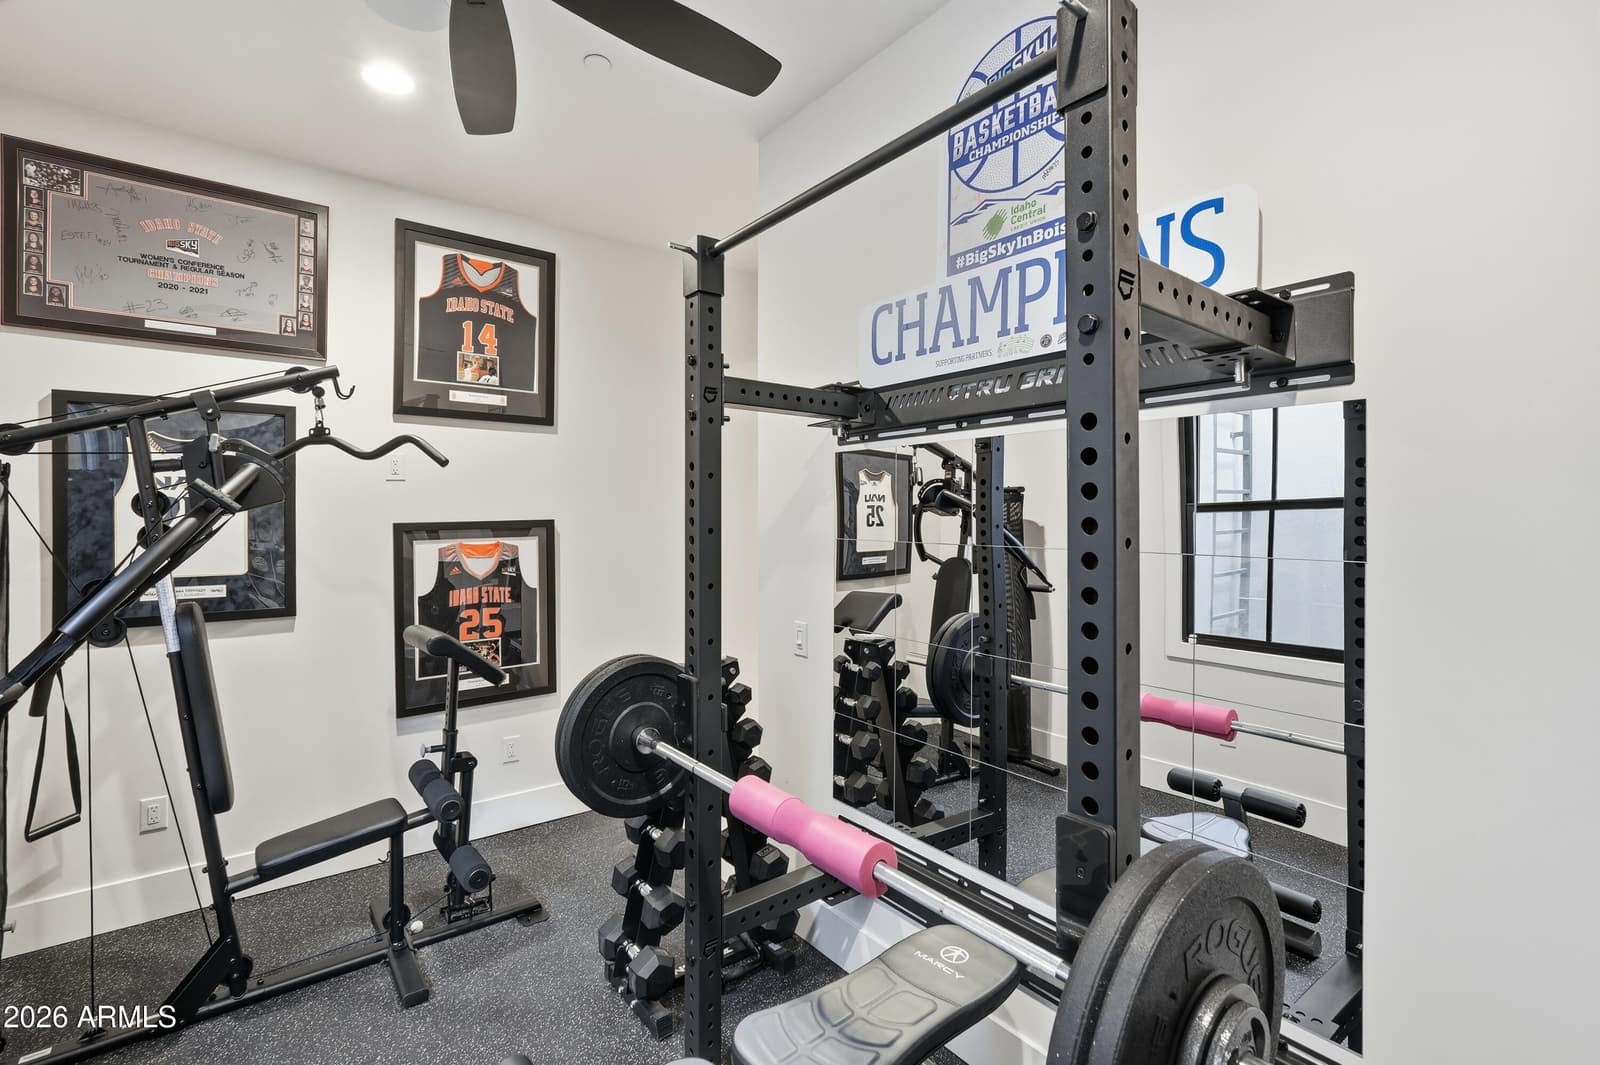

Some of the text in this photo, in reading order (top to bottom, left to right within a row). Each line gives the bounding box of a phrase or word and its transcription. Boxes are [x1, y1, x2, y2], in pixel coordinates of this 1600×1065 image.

[953, 84, 1057, 162] BASKETBA
[969, 111, 1064, 161] CHAMPIONSHIP
[1010, 199, 1037, 214] Idaho
[1010, 204, 1046, 225] Central
[955, 222, 1065, 269] #BigSkyInBois
[117, 255, 169, 269] TOURNAMENT
[180, 264, 214, 275] REGULAR
[216, 269, 245, 279] SEASON
[177, 258, 225, 270] CONFERENCE
[158, 281, 179, 291] 2020
[189, 286, 208, 295] 2021
[446, 297, 514, 323] IDAHO STATE
[461, 320, 498, 356] 14
[1019, 364, 1065, 390] GRI
[448, 586, 513, 607] IDAHO STATE
[459, 607, 503, 641] 25
[913, 950, 966, 979] MARCY
